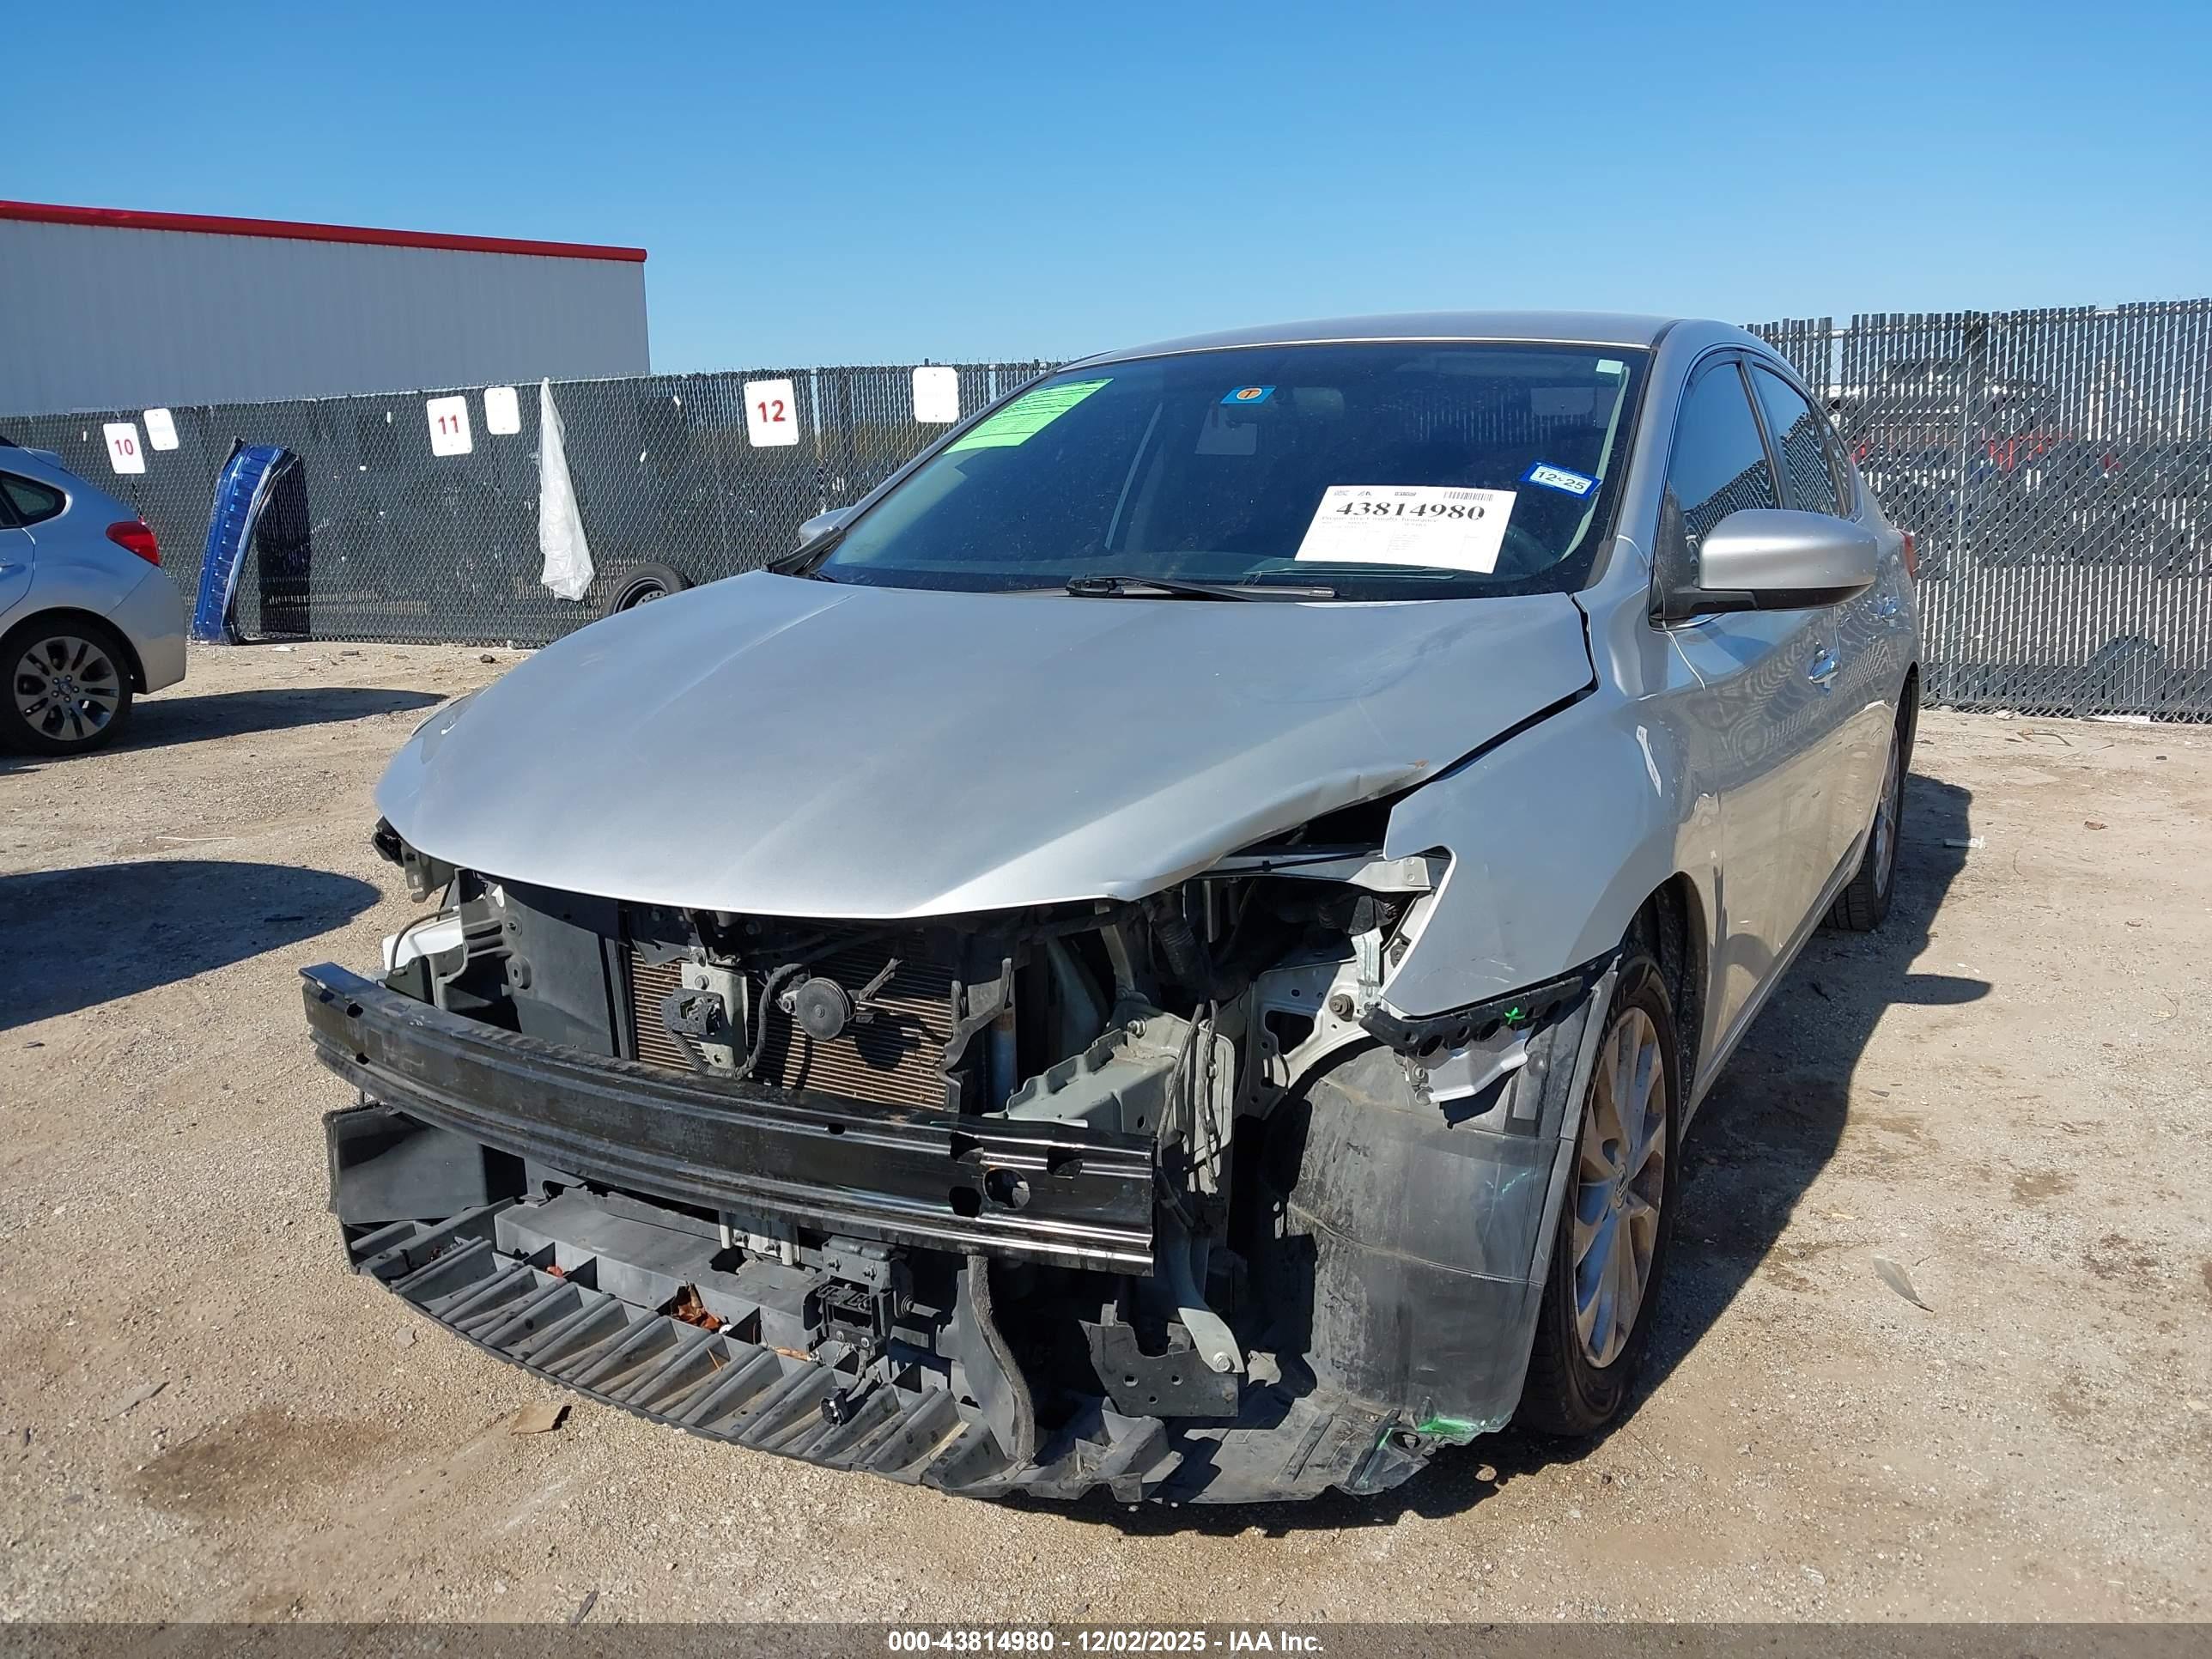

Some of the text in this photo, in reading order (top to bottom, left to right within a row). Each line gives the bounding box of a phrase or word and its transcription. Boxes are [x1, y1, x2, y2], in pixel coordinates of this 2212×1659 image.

[757, 399, 786, 422] 12
[438, 414, 459, 434] 11
[114, 439, 134, 456] 10
[1336, 501, 1485, 520] 43814980
